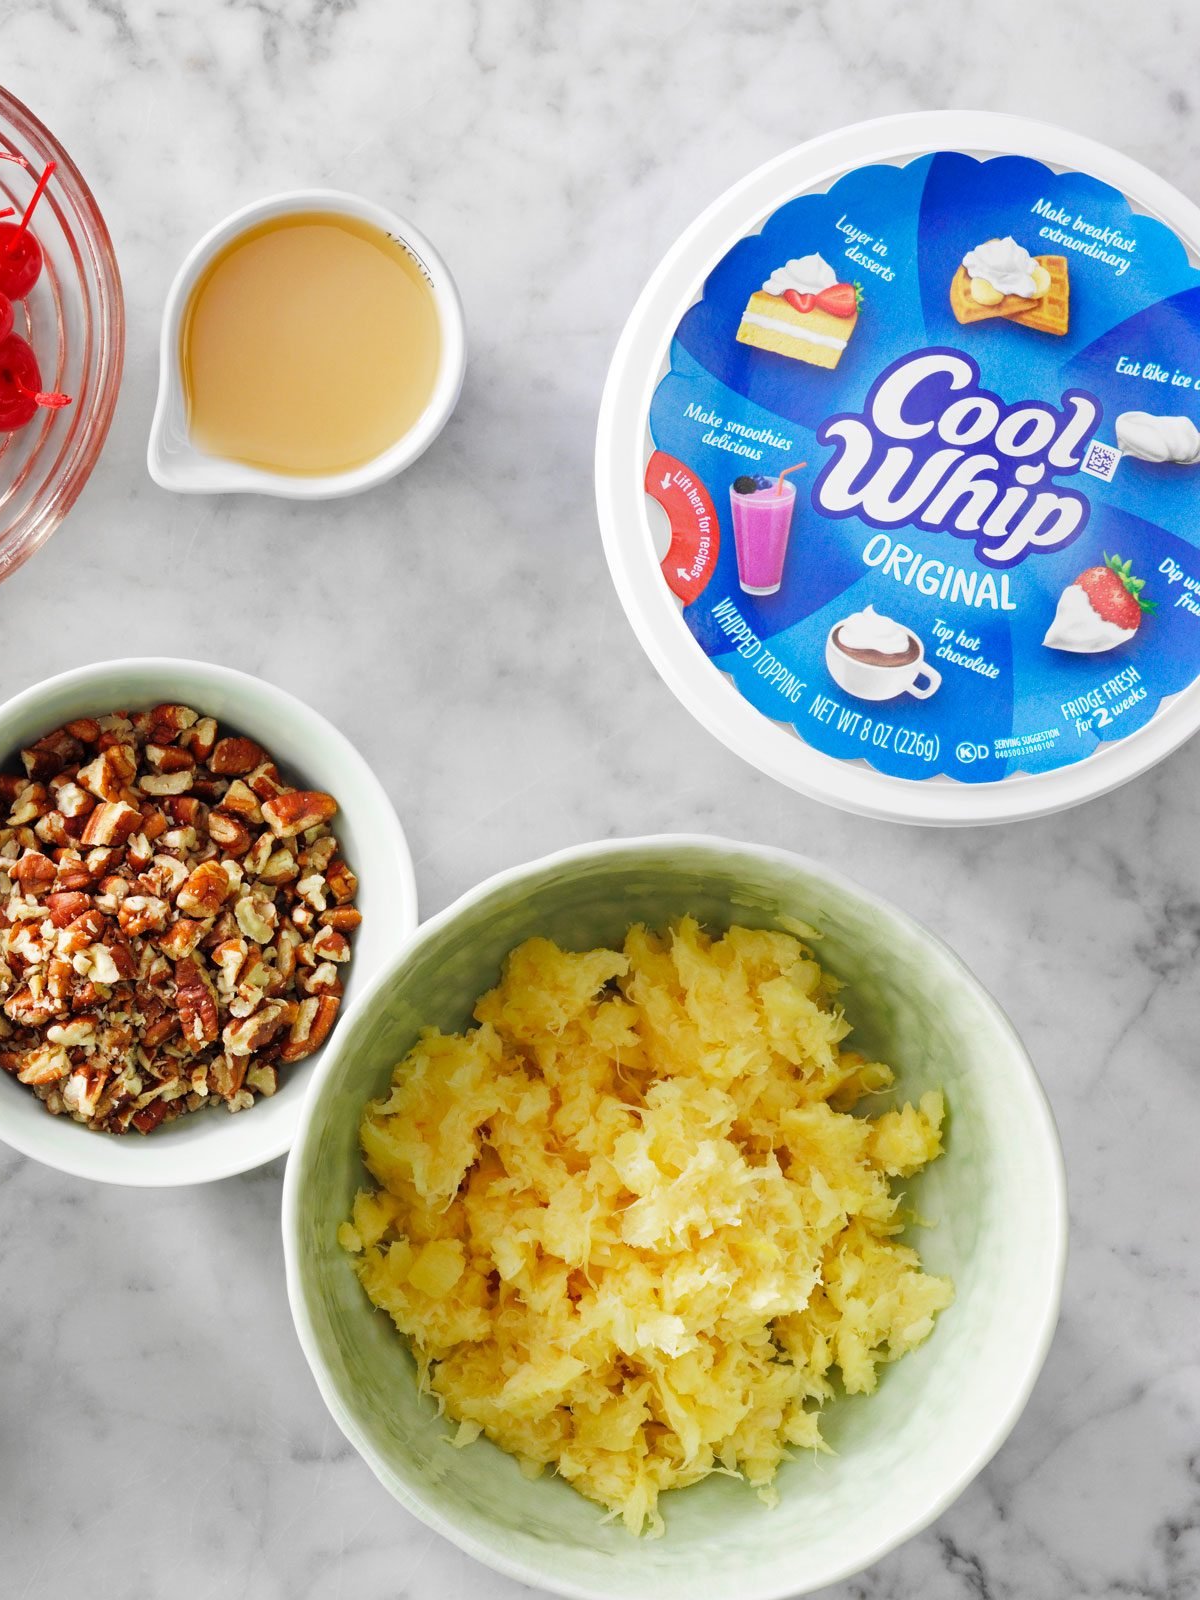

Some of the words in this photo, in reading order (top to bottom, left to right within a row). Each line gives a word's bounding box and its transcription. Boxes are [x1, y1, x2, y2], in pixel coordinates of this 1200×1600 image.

[835, 214, 874, 246] Layer
[872, 238, 888, 257] in
[1030, 198, 1072, 226] Make
[1072, 214, 1137, 253] breakfast
[844, 245, 896, 282] desserts
[1039, 226, 1131, 276] extraordinary
[1115, 356, 1141, 377] Eat
[1142, 363, 1170, 383] like
[1171, 369, 1192, 388] ice
[683, 402, 723, 428] Make
[724, 421, 793, 451] smoothies
[872, 354, 1096, 468] Cool
[702, 430, 763, 461] delicious
[673, 470, 693, 492] Lift
[687, 488, 705, 515] here
[819, 419, 1084, 561] Whip
[698, 516, 711, 534] for
[690, 537, 711, 578] recipes
[862, 533, 1017, 611] ORIGINAL
[1158, 557, 1184, 584] Dip
[711, 597, 762, 659] WHIPPED
[752, 649, 808, 704] TOPPING
[931, 618, 955, 645] Top
[955, 629, 981, 652] hot
[935, 644, 1000, 679] chocolate
[1061, 688, 1106, 721] FRIDGE
[1102, 665, 1142, 700] FRESH
[1075, 717, 1093, 738] for
[1091, 707, 1114, 728] 2
[1111, 687, 1148, 716] weeks
[808, 694, 840, 725] NET
[836, 707, 863, 737] WT
[860, 718, 873, 741] 8
[872, 723, 894, 749] OZ
[894, 727, 941, 762] (226g)
[994, 737, 1021, 750] SERVING
[1021, 728, 1060, 745] SUGGESTION
